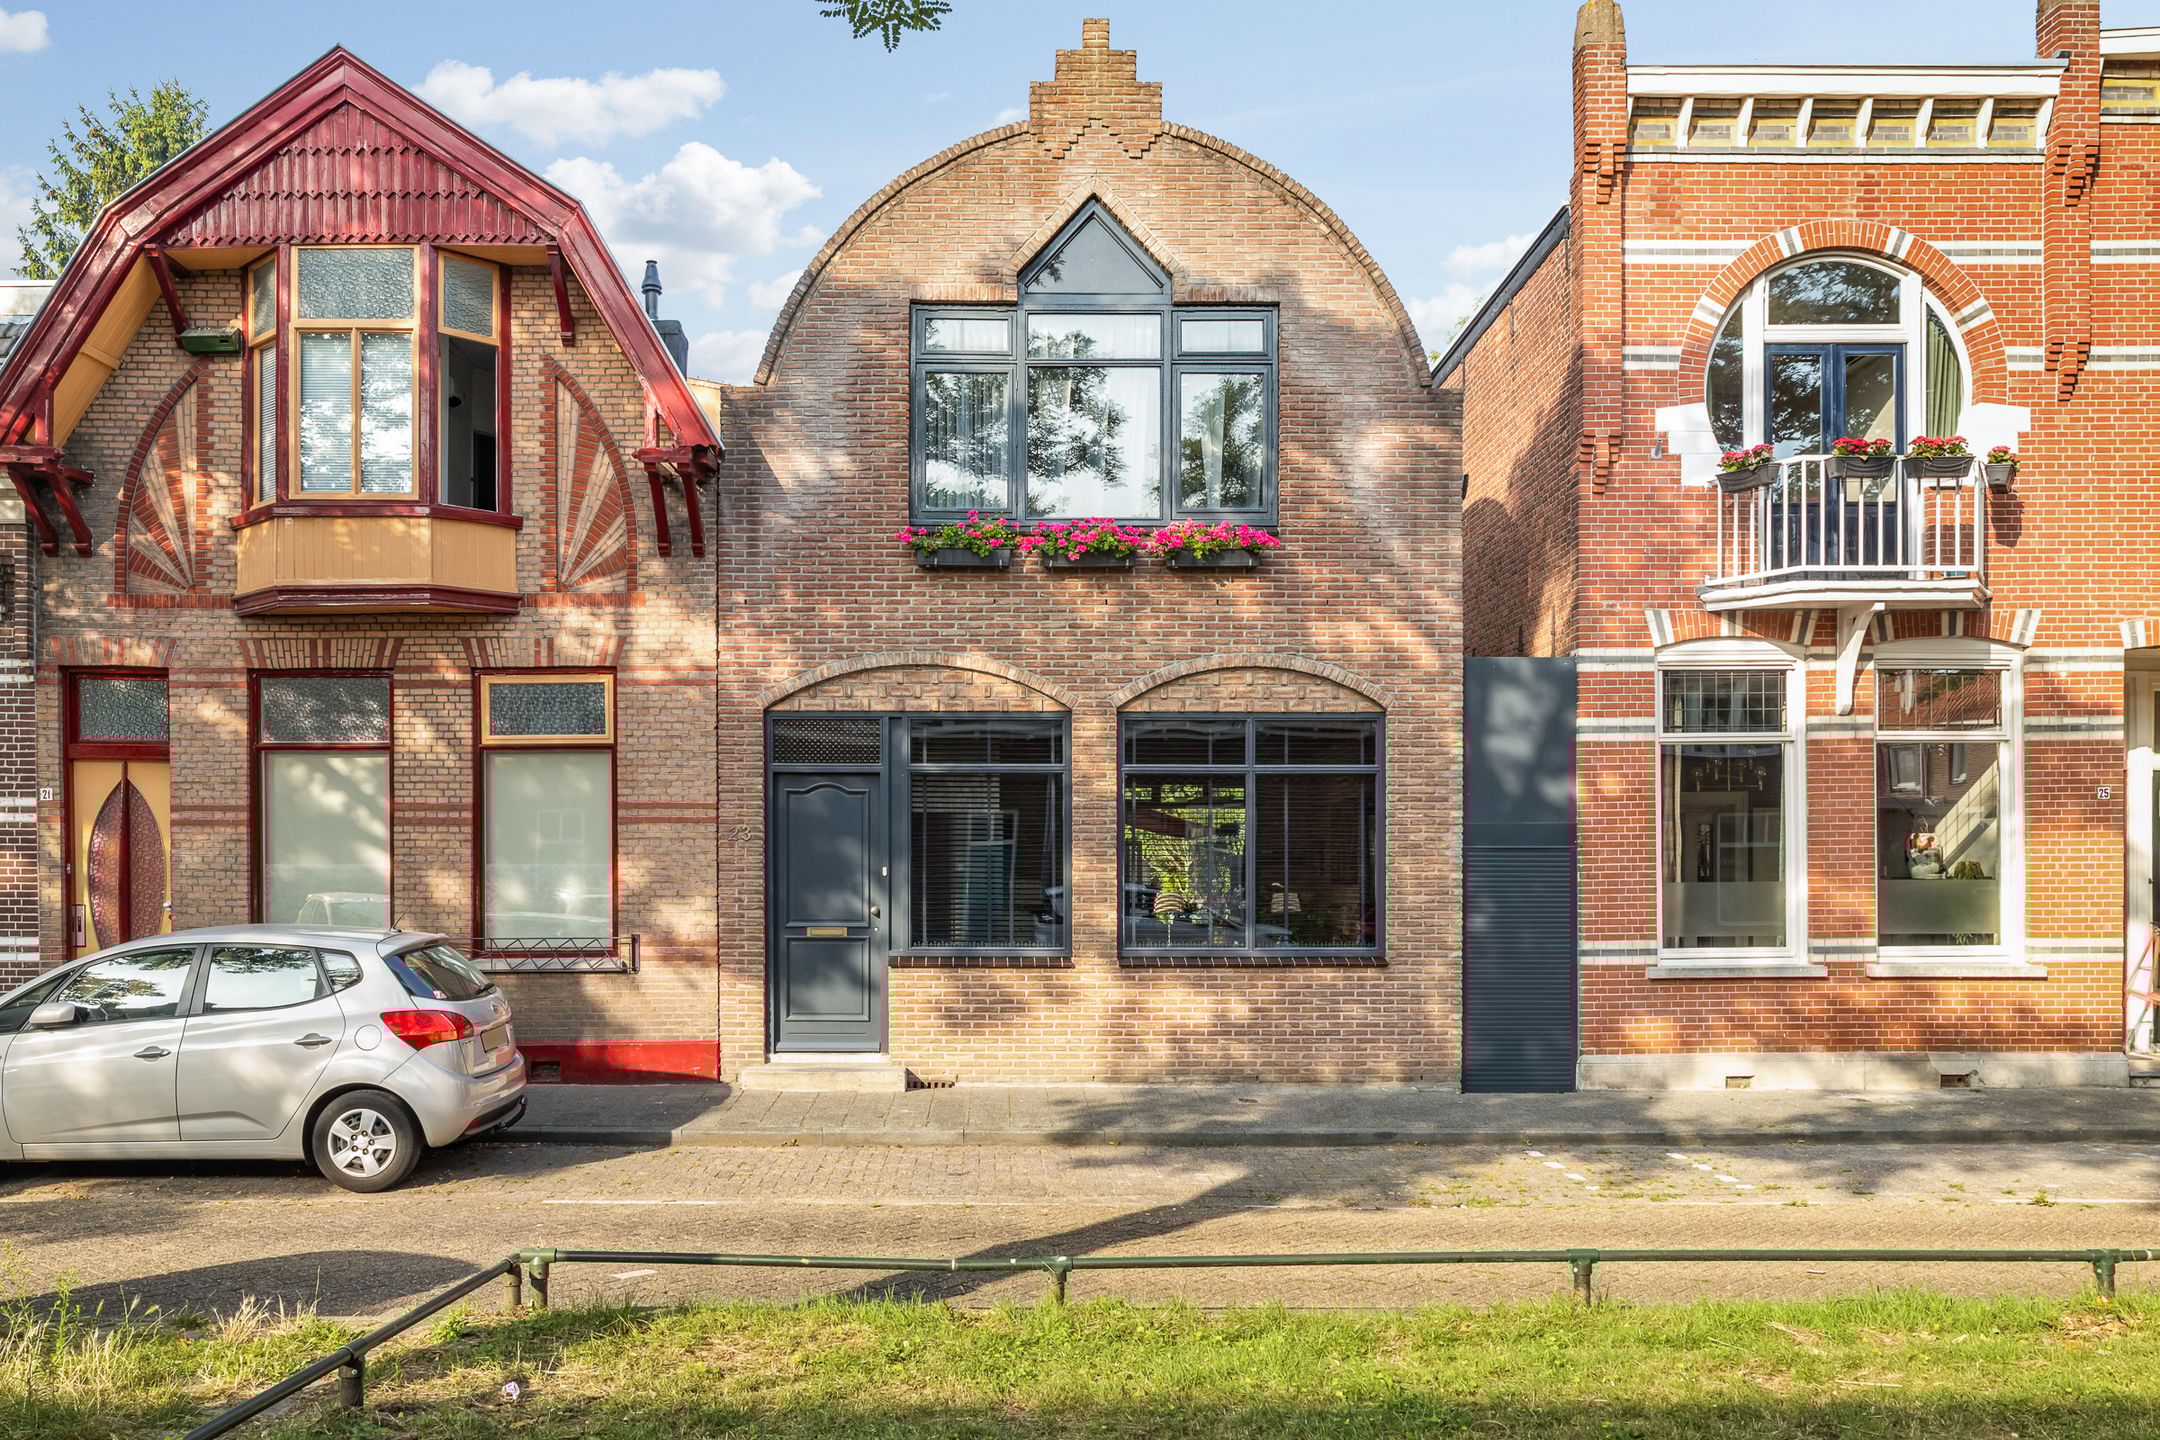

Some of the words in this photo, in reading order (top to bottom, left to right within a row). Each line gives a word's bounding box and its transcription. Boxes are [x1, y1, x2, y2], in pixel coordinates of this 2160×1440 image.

[42, 789, 51, 800] 21
[2099, 788, 2109, 798] 25
[727, 826, 752, 842] 23
